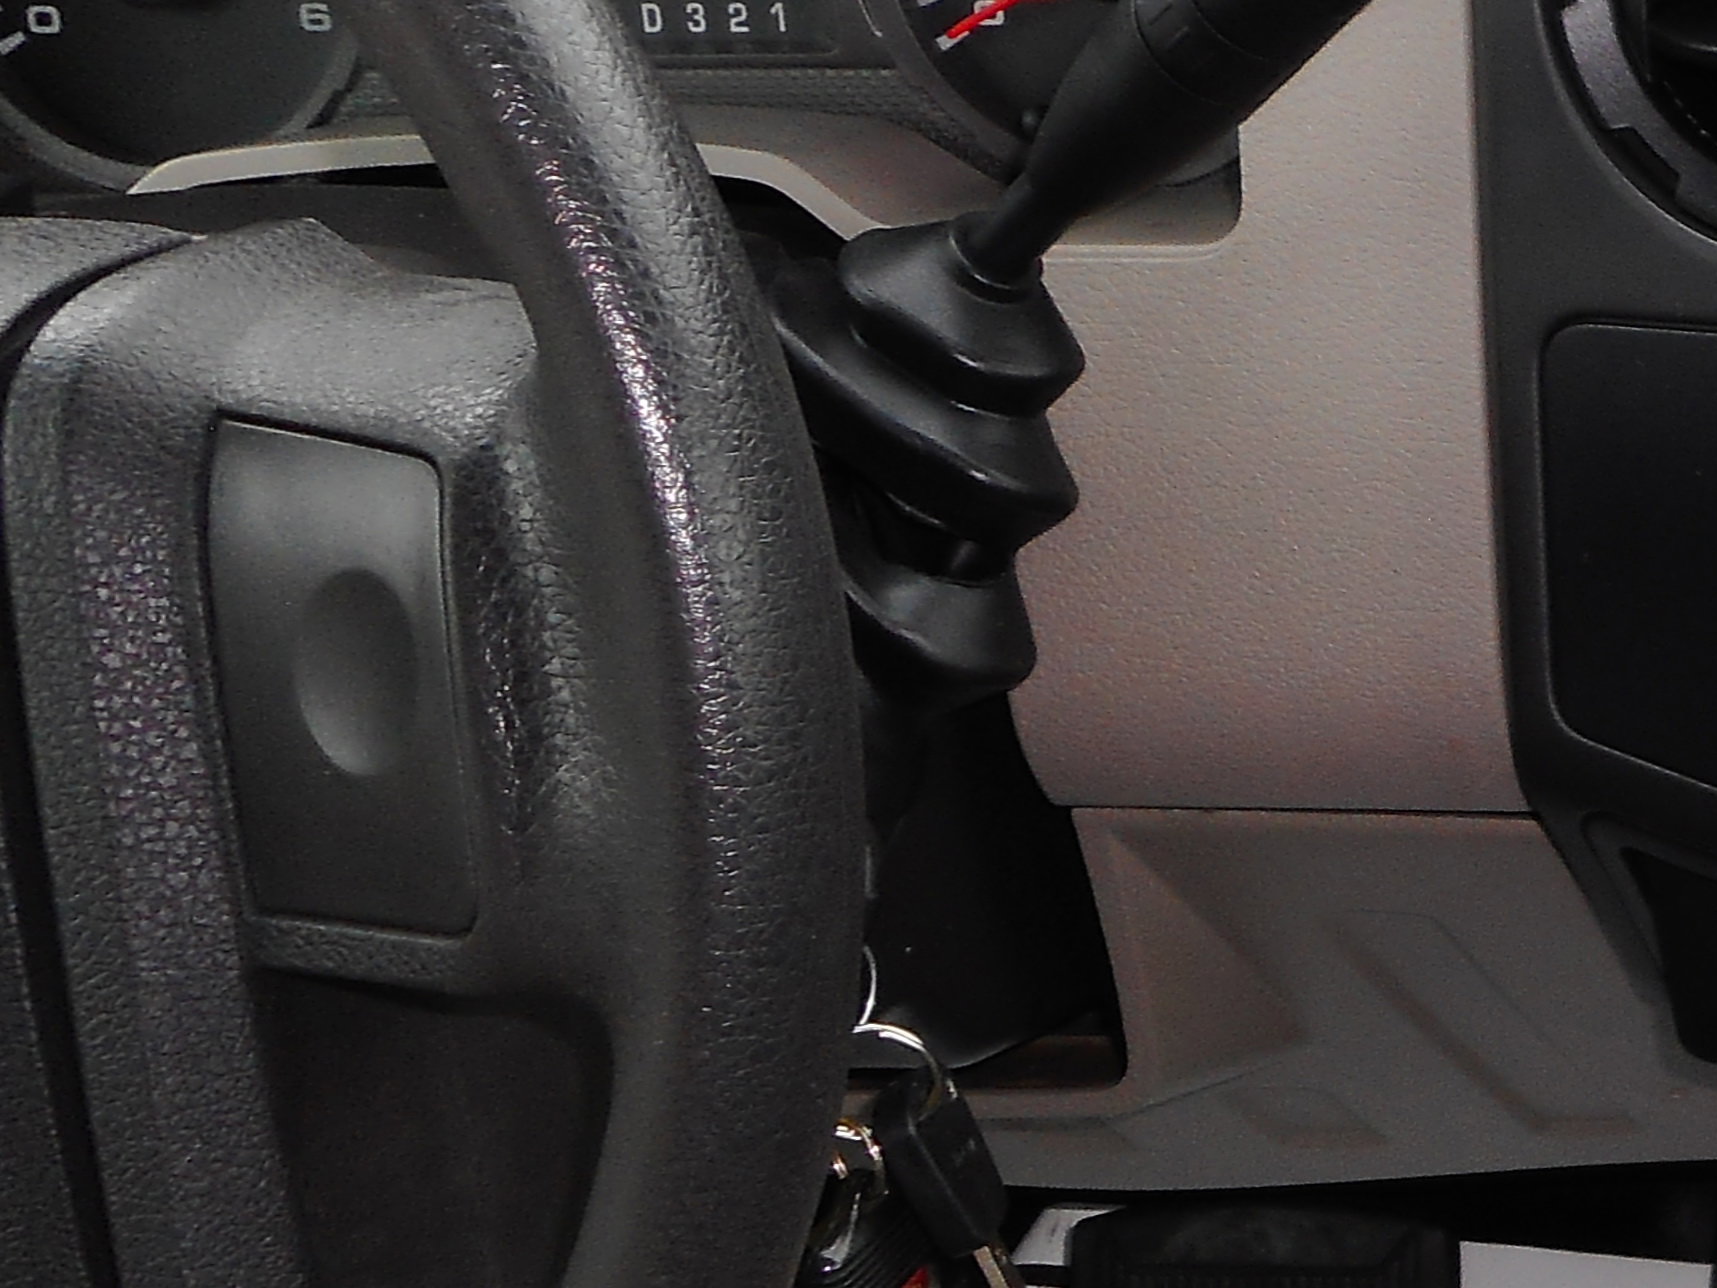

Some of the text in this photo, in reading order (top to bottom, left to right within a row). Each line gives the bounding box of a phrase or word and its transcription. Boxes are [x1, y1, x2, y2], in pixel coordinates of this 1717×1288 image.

[26, 5, 63, 34] 0
[299, 2, 333, 32] 6
[641, 2, 787, 33] D 3 2 1
